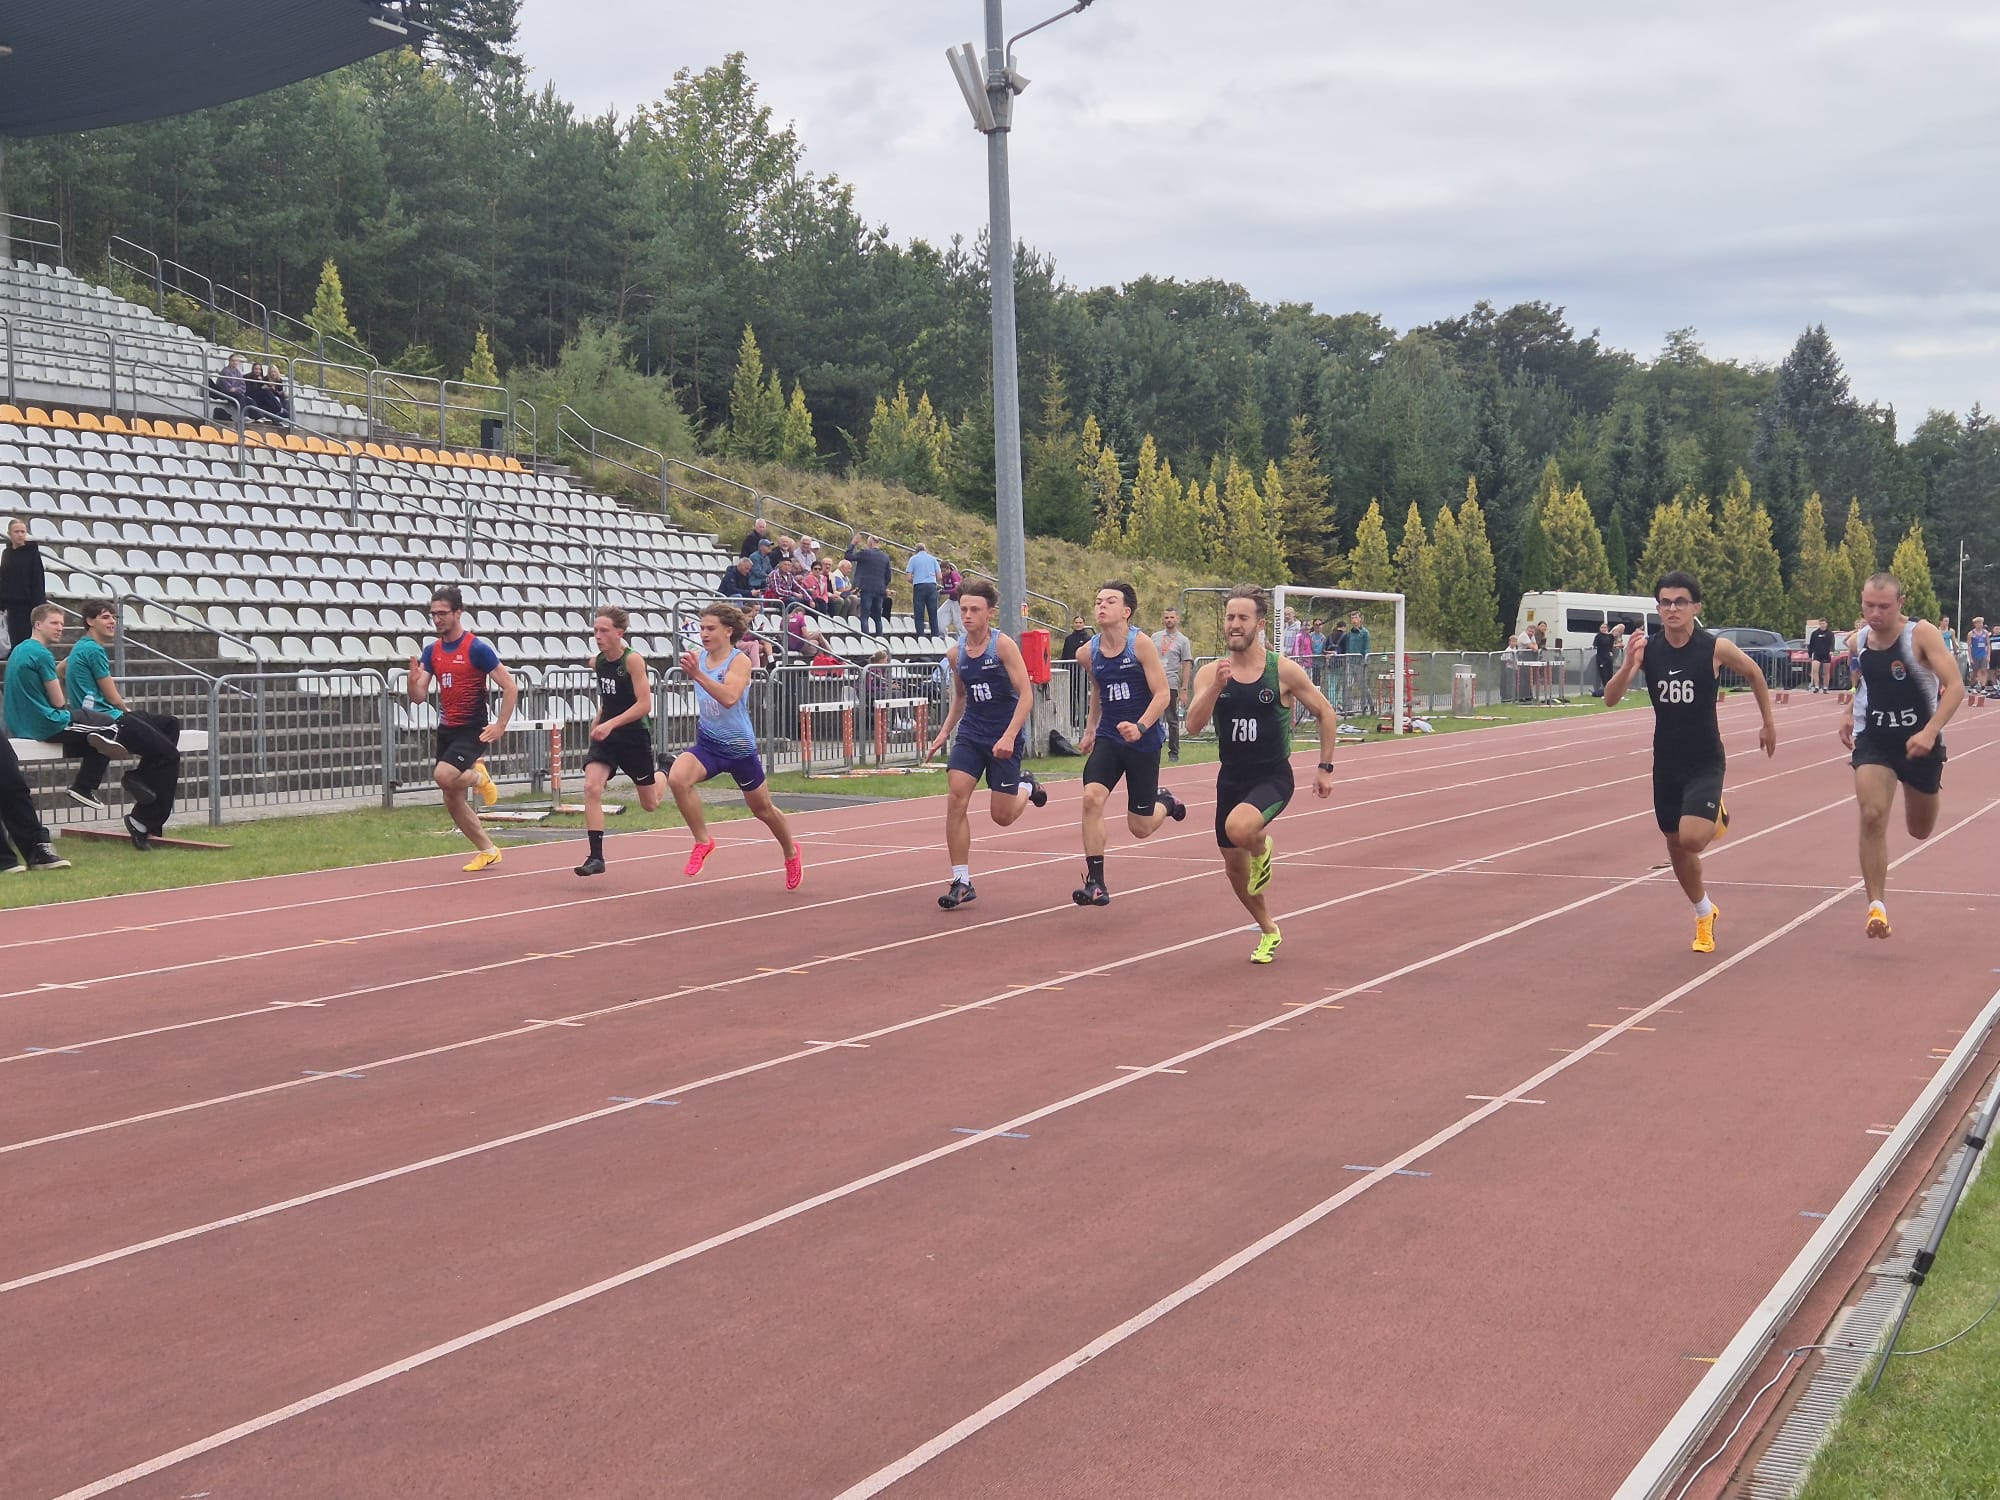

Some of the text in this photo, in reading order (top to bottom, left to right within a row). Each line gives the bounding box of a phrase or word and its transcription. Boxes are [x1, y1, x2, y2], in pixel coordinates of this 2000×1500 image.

[1657, 680, 1694, 703] 266
[1871, 708, 1918, 727] 715
[1231, 718, 1257, 742] 738
